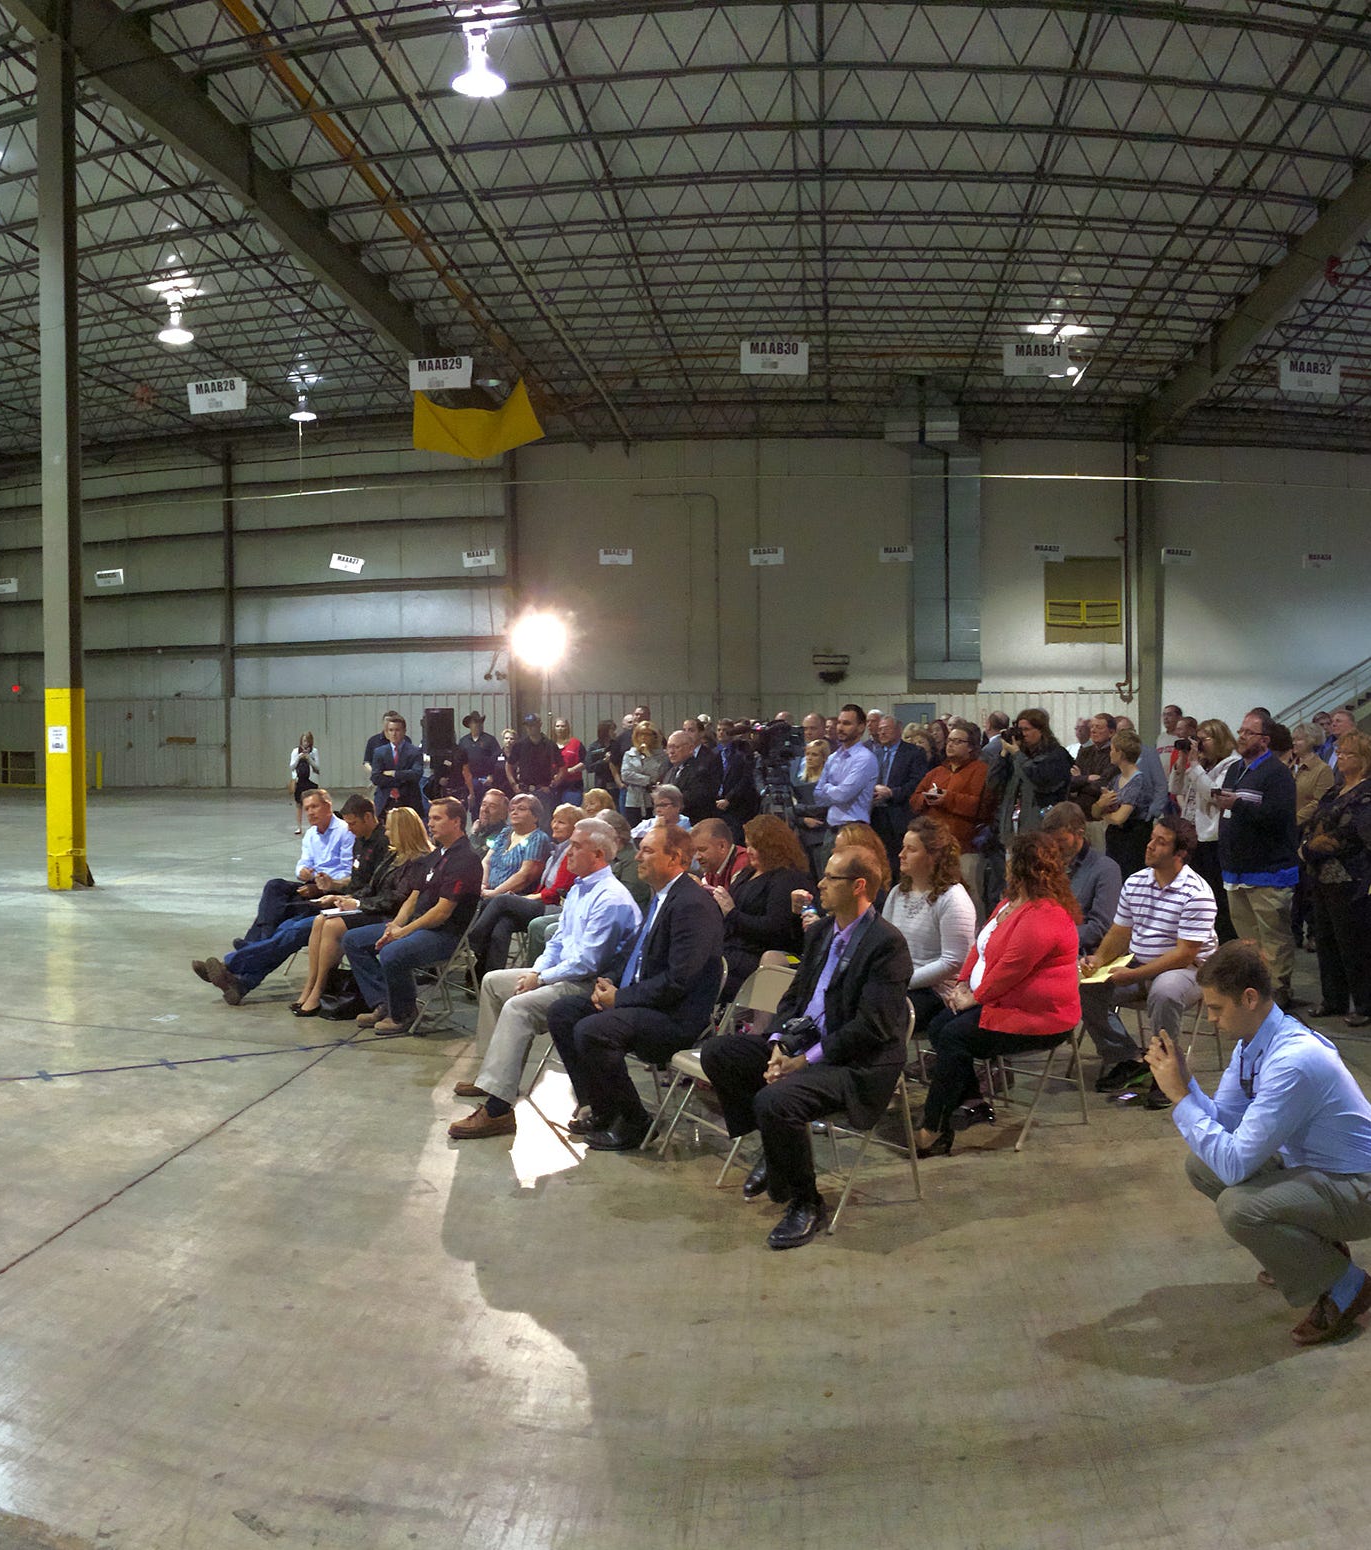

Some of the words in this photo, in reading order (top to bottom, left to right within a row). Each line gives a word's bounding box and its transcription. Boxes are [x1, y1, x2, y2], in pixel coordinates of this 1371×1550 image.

[750, 342, 799, 355] MAAB30
[1015, 344, 1061, 357] MAAB31
[417, 358, 463, 373] MAAB29
[1289, 360, 1333, 375] MAAB32
[195, 380, 236, 395] MAAB28
